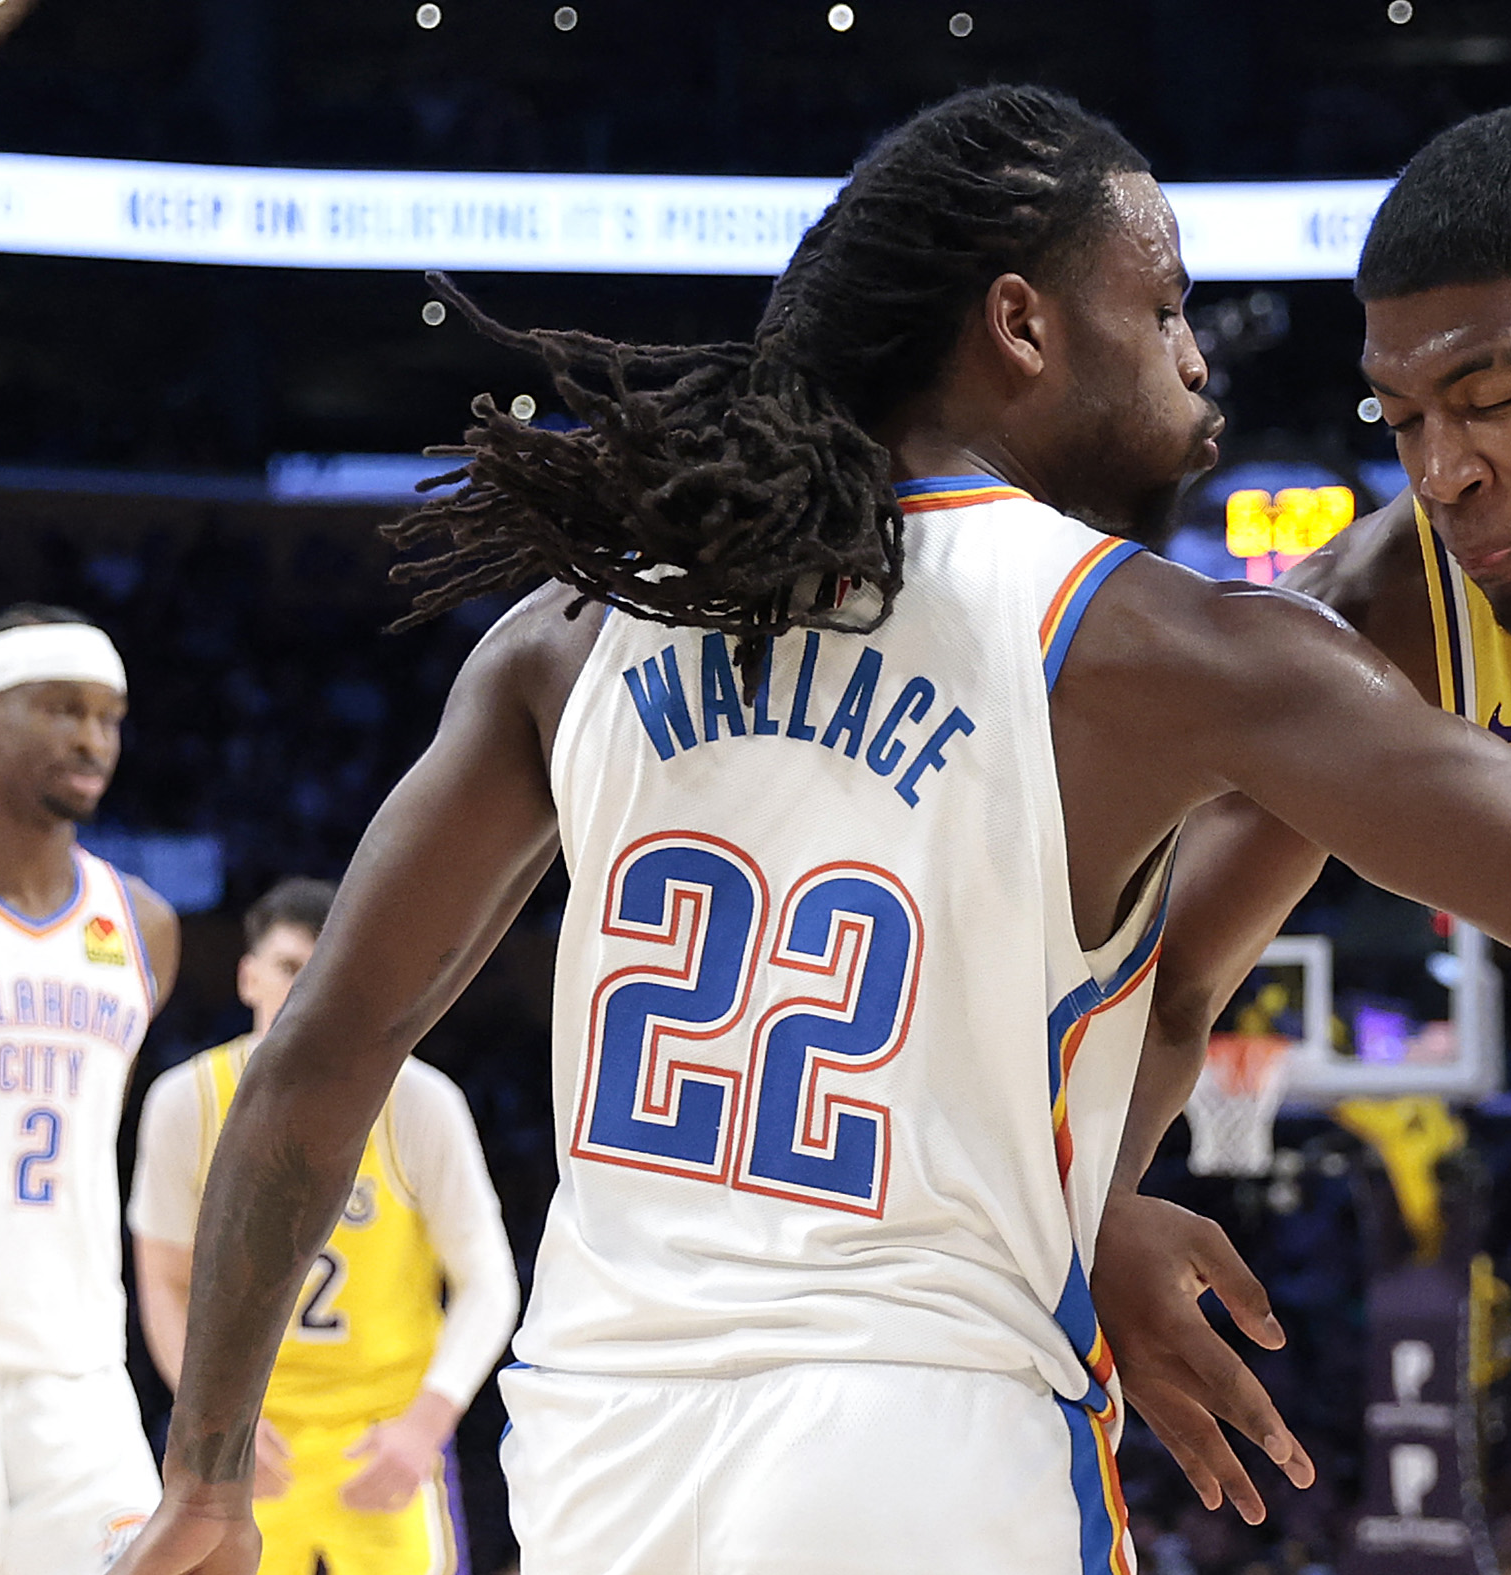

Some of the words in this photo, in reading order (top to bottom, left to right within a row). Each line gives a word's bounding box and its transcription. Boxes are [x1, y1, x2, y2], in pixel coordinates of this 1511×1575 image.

[623, 630, 977, 809] WALLACE
[570, 829, 925, 1220] 22
[14, 1105, 62, 1206] 2
